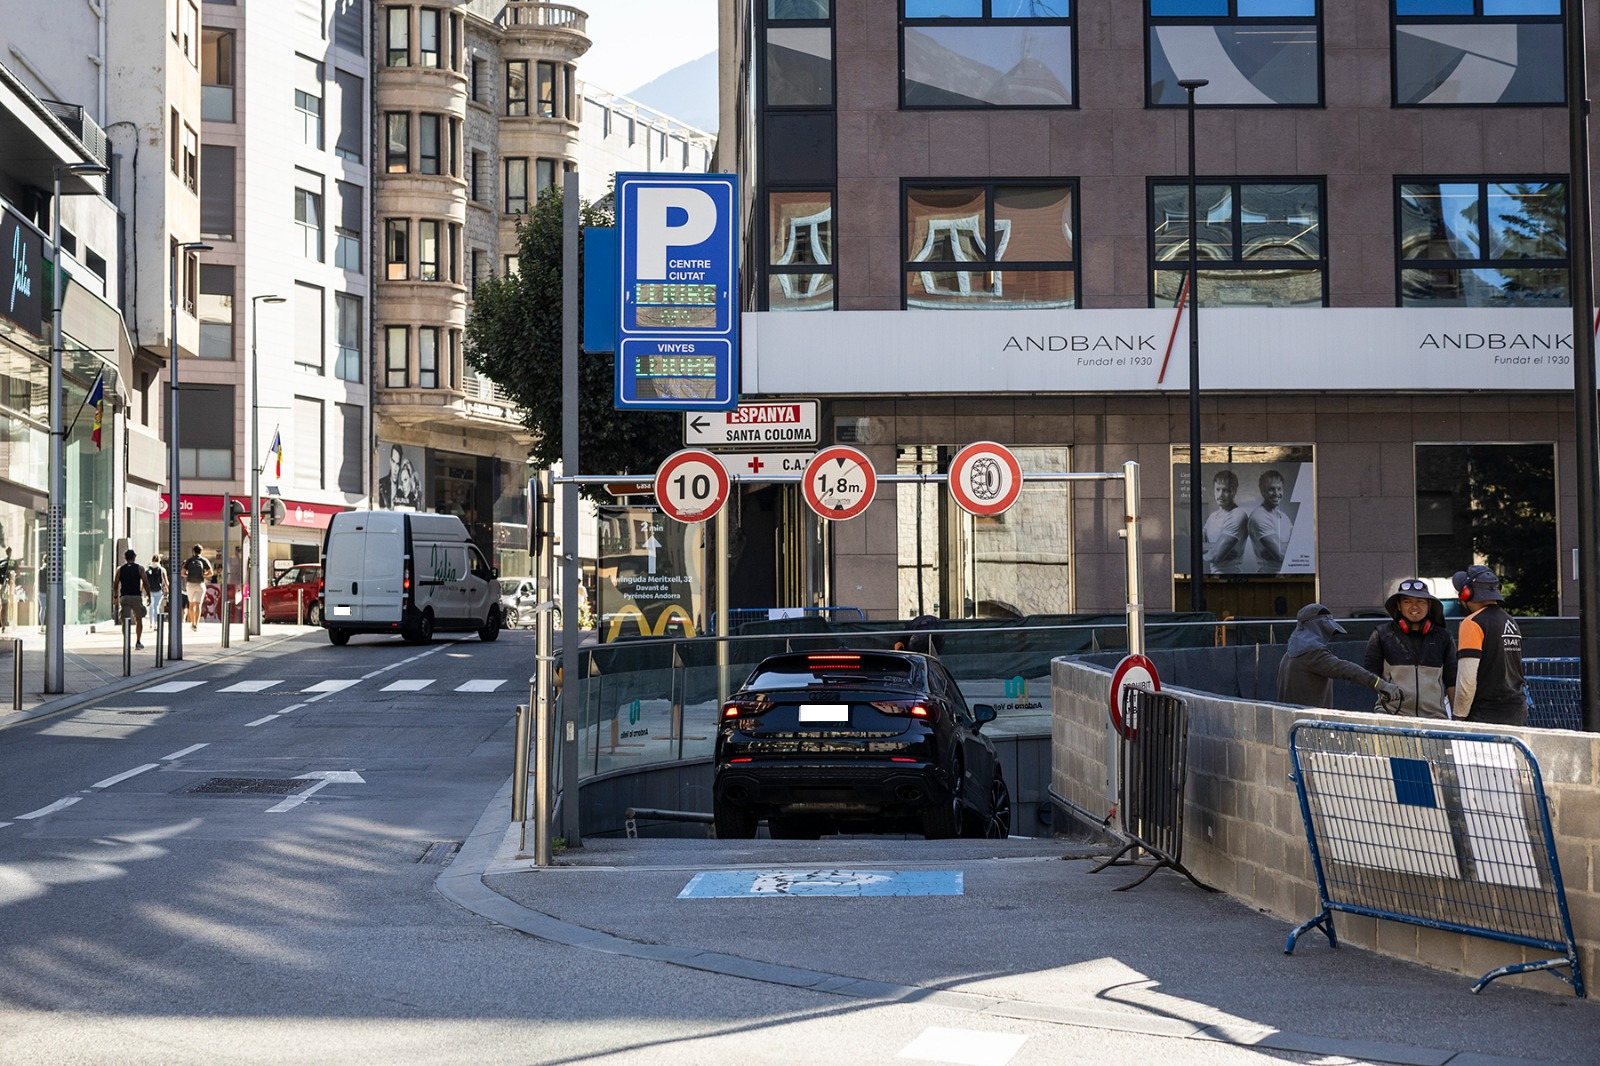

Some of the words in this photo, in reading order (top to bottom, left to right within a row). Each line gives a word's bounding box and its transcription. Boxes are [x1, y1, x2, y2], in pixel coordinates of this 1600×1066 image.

[636, 187, 717, 280] P
[669, 260, 711, 269] CENTRE
[669, 272, 706, 280] CIUTAT
[1002, 335, 1157, 351] ANDBANK
[1419, 333, 1574, 350] ANDBANK
[657, 343, 695, 353] VINYES
[1077, 356, 1114, 366] Fundat
[1116, 356, 1126, 366] el
[1130, 356, 1153, 366] 1930
[1494, 355, 1531, 365] Fundat
[1533, 355, 1543, 365] el
[1547, 355, 1570, 365] 1930
[731, 406, 796, 424] ESPANYA
[726, 429, 762, 442] SANTA
[764, 428, 812, 441] COLOMA
[782, 457, 810, 471] C.A.
[673, 474, 711, 500] 10
[179, 499, 193, 510] ala
[640, 520, 648, 532] 2
[648, 575, 683, 584] Meritxell,
[684, 575, 693, 583] 32
[623, 592, 654, 600] Pyrénées
